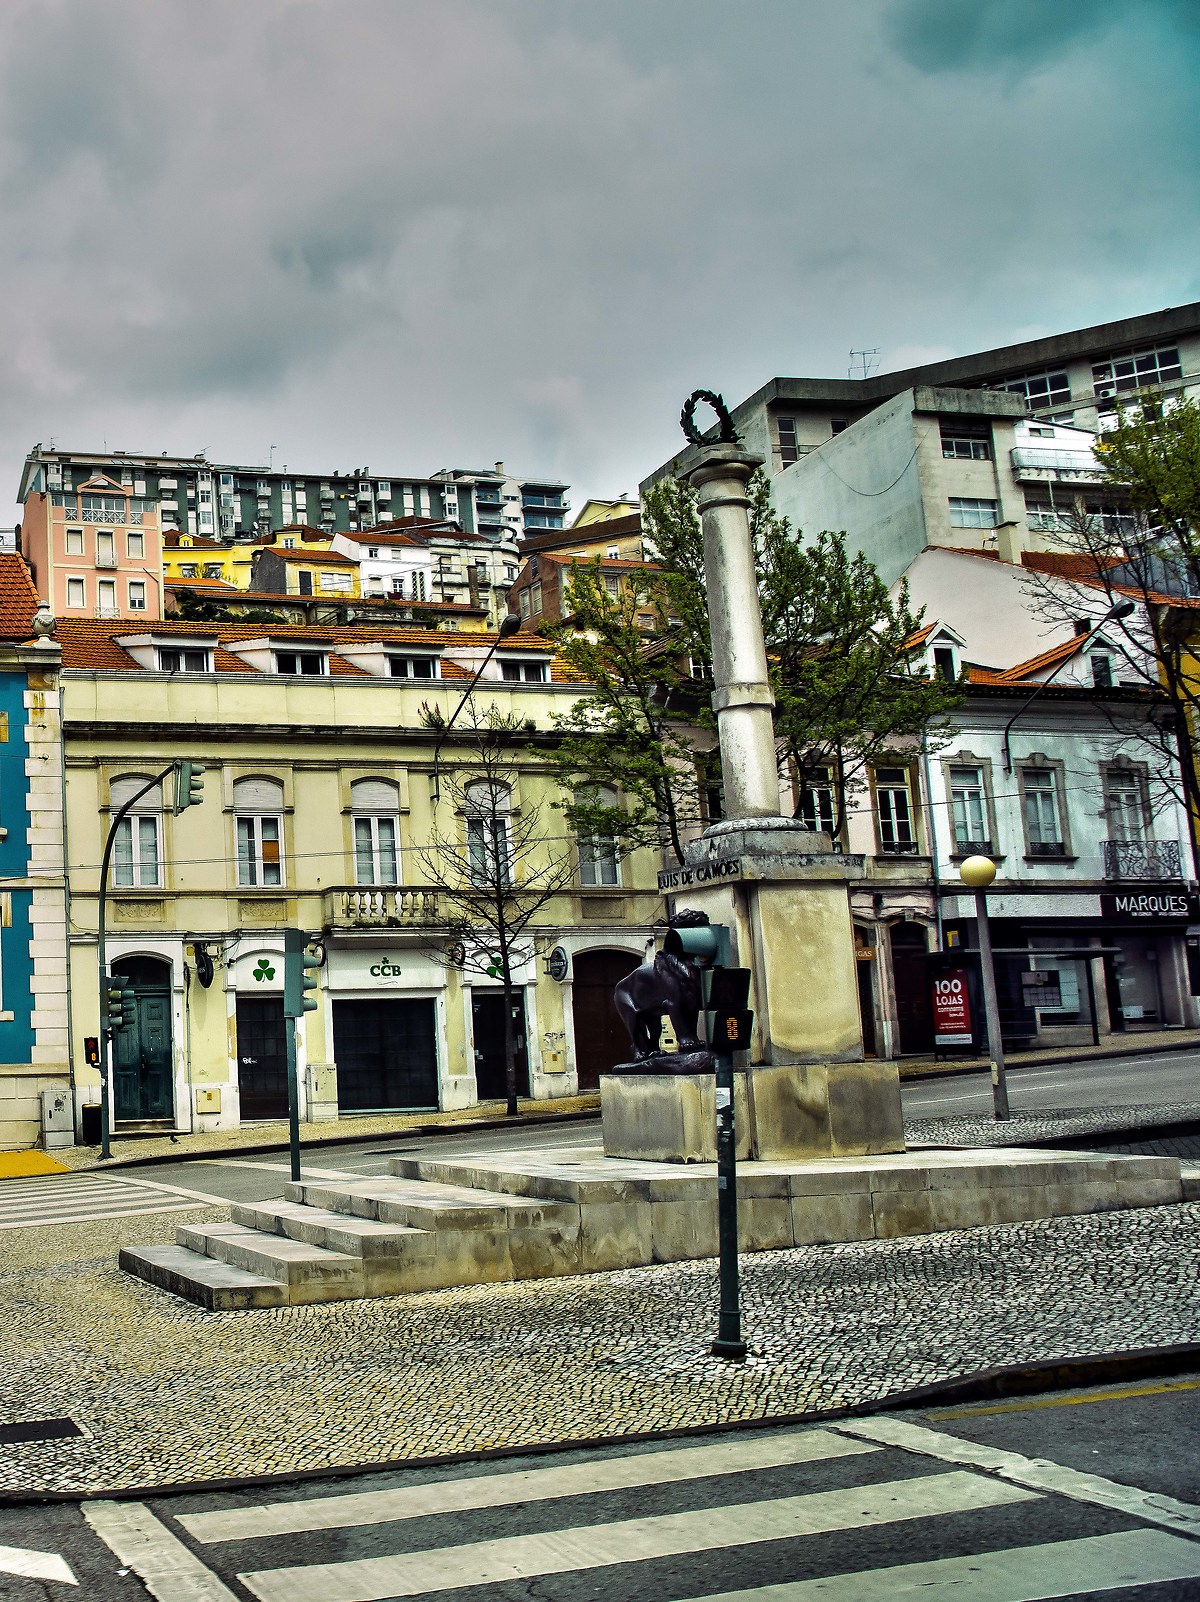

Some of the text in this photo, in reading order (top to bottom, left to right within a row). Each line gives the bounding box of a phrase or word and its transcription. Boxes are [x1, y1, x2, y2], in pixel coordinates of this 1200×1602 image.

[657, 872, 679, 889] LUIS
[681, 870, 694, 885] DE
[1115, 895, 1188, 912] MARQUES
[370, 965, 402, 976] CCB
[935, 979, 962, 995] 100
[936, 995, 963, 1006] LOJAS
